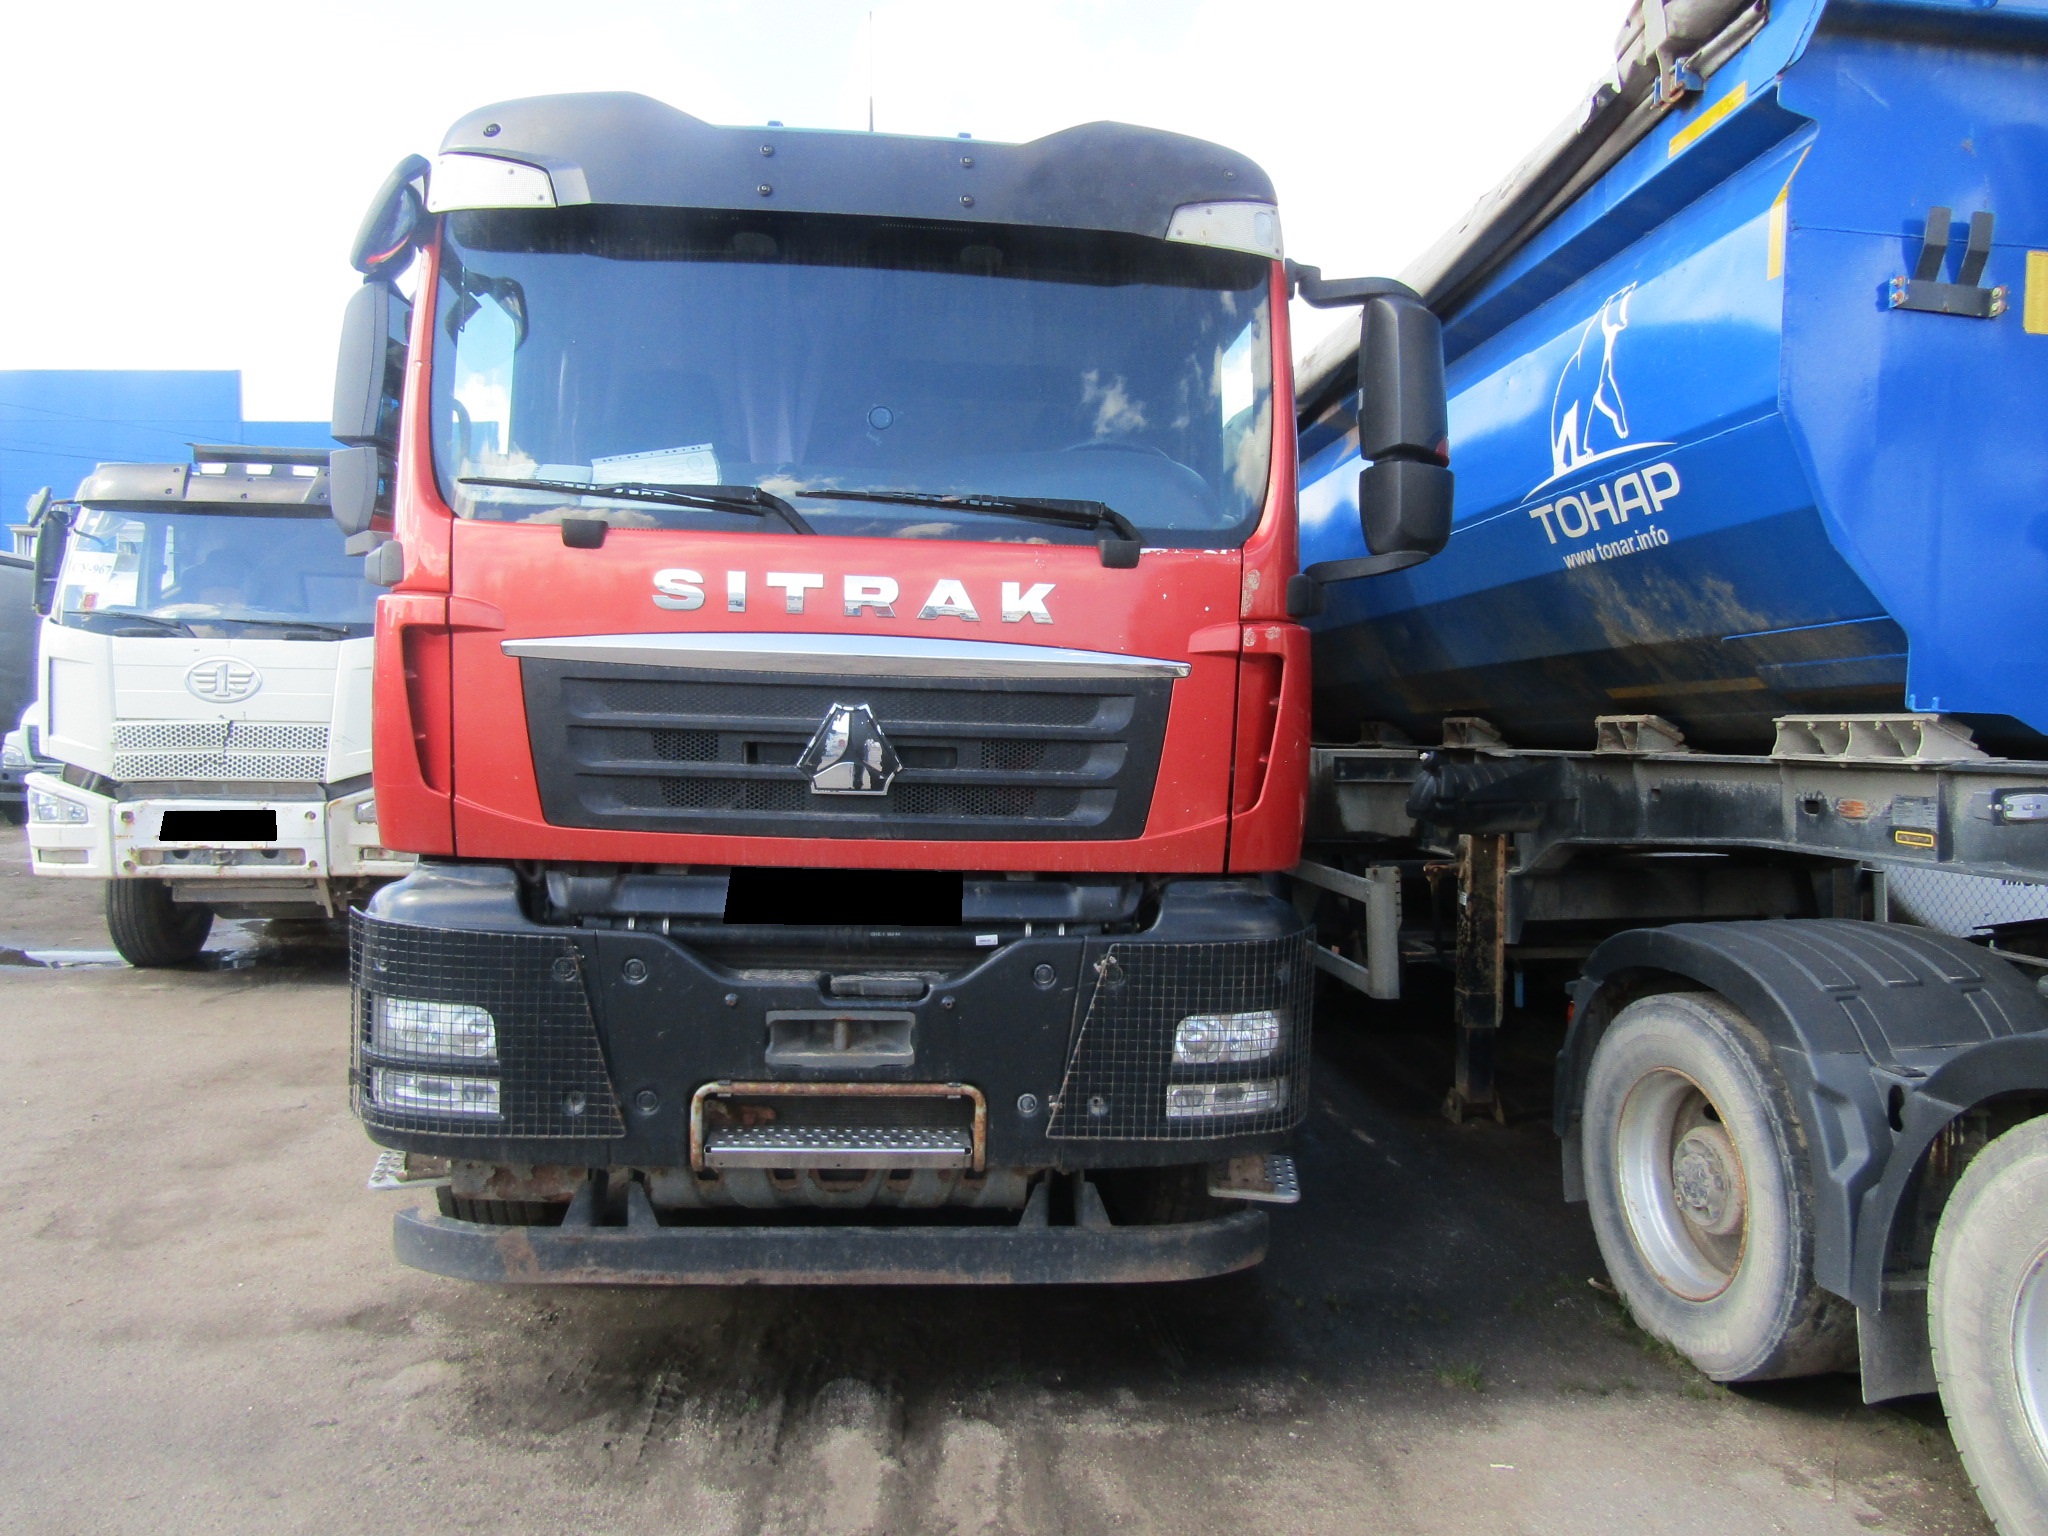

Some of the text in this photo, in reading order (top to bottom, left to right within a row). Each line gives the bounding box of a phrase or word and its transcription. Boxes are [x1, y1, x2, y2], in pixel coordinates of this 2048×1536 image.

[1528, 462, 1681, 545] ТОНАР
[1562, 524, 1669, 570] www tonar.info
[652, 568, 1057, 625] SITRAK
